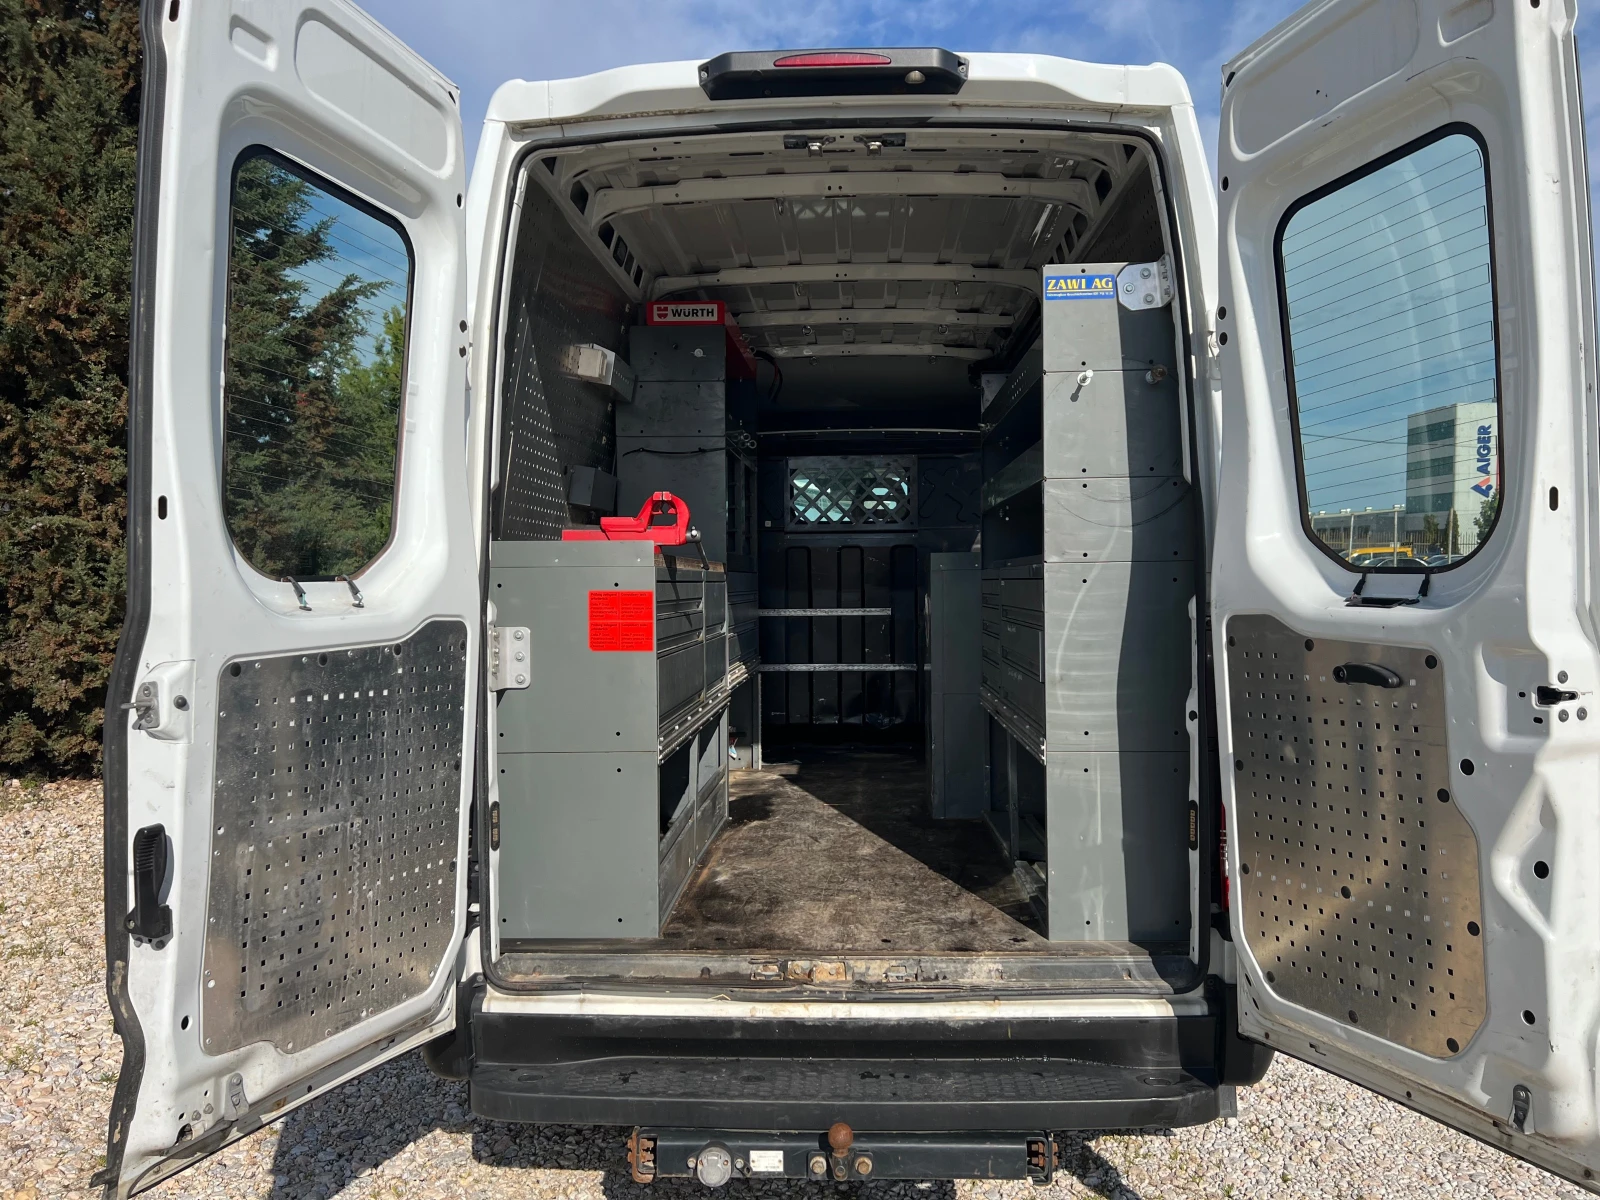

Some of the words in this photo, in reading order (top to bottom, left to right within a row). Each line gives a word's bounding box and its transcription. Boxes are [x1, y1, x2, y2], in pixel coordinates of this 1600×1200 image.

[1047, 278, 1086, 290] ZAWI
[1091, 277, 1113, 289] AG
[671, 308, 715, 318] WÜRTH
[1476, 424, 1492, 475] AIGER
